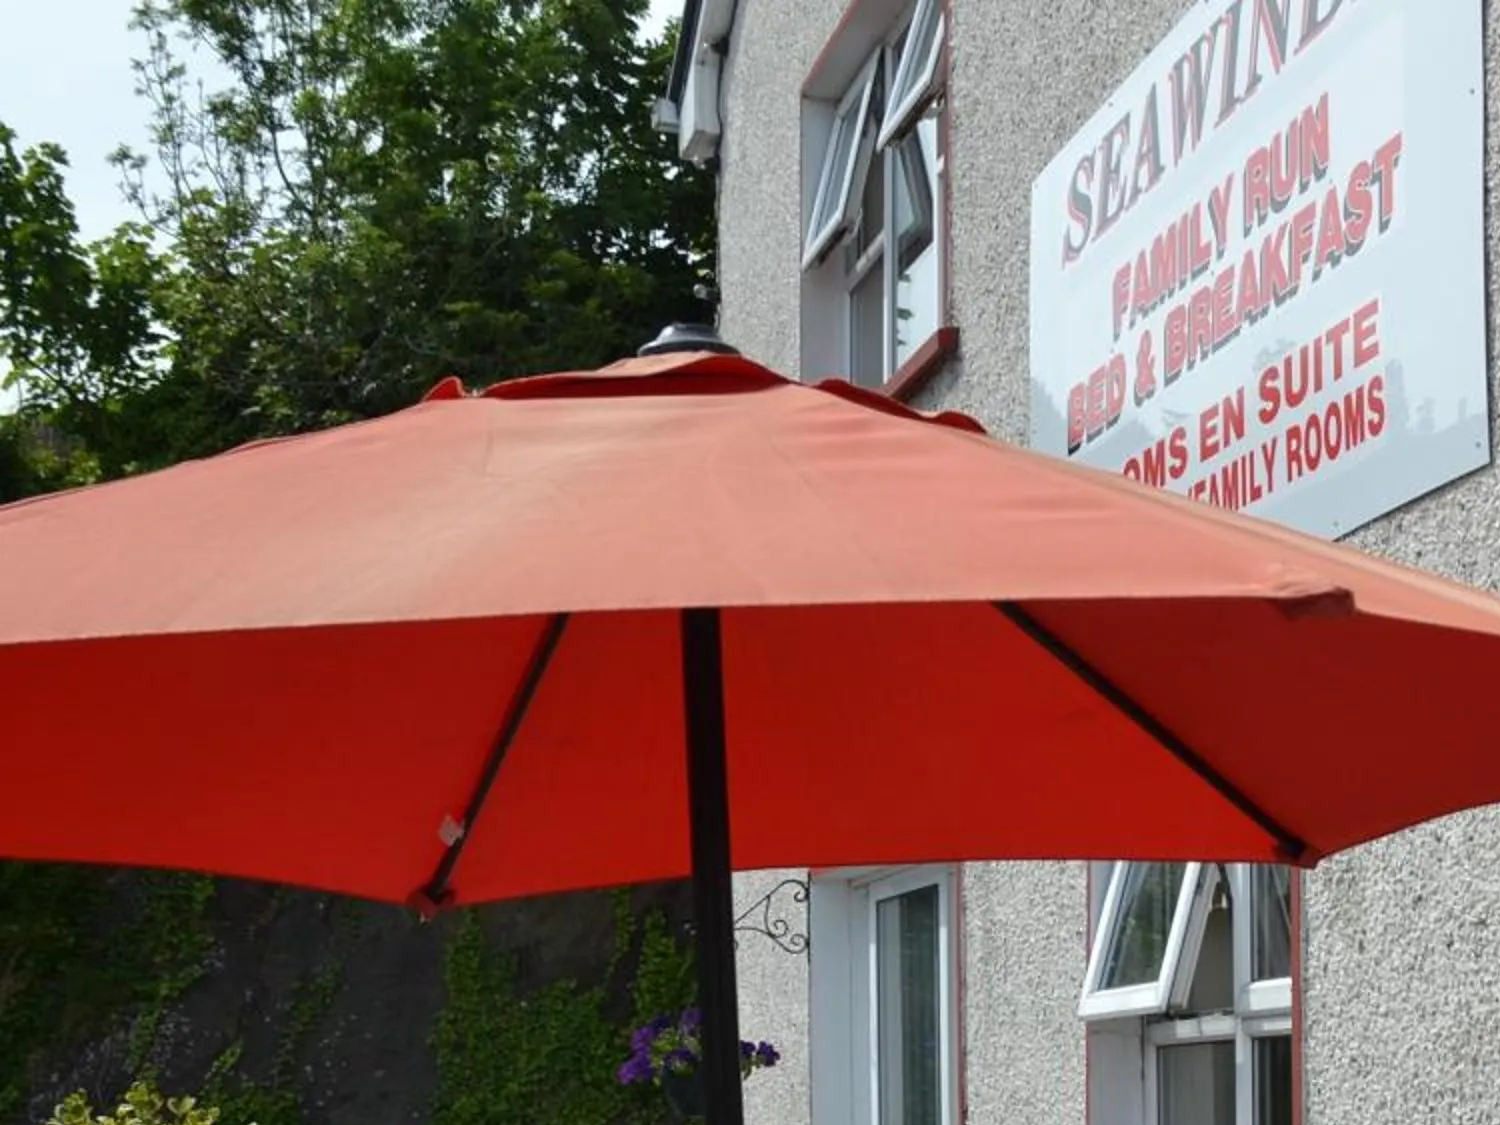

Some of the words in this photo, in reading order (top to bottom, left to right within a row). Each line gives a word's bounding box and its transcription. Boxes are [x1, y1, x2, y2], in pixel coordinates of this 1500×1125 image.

[1067, 352, 1126, 456] BED
[1134, 330, 1156, 407] &
[1164, 131, 1402, 388] BREAKFAST
[1112, 173, 1234, 342] FAMILY
[1243, 91, 1330, 239] RUN
[1200, 386, 1245, 462] EN
[1258, 299, 1380, 425] SUITE
[1286, 375, 1386, 483] ROOMS
